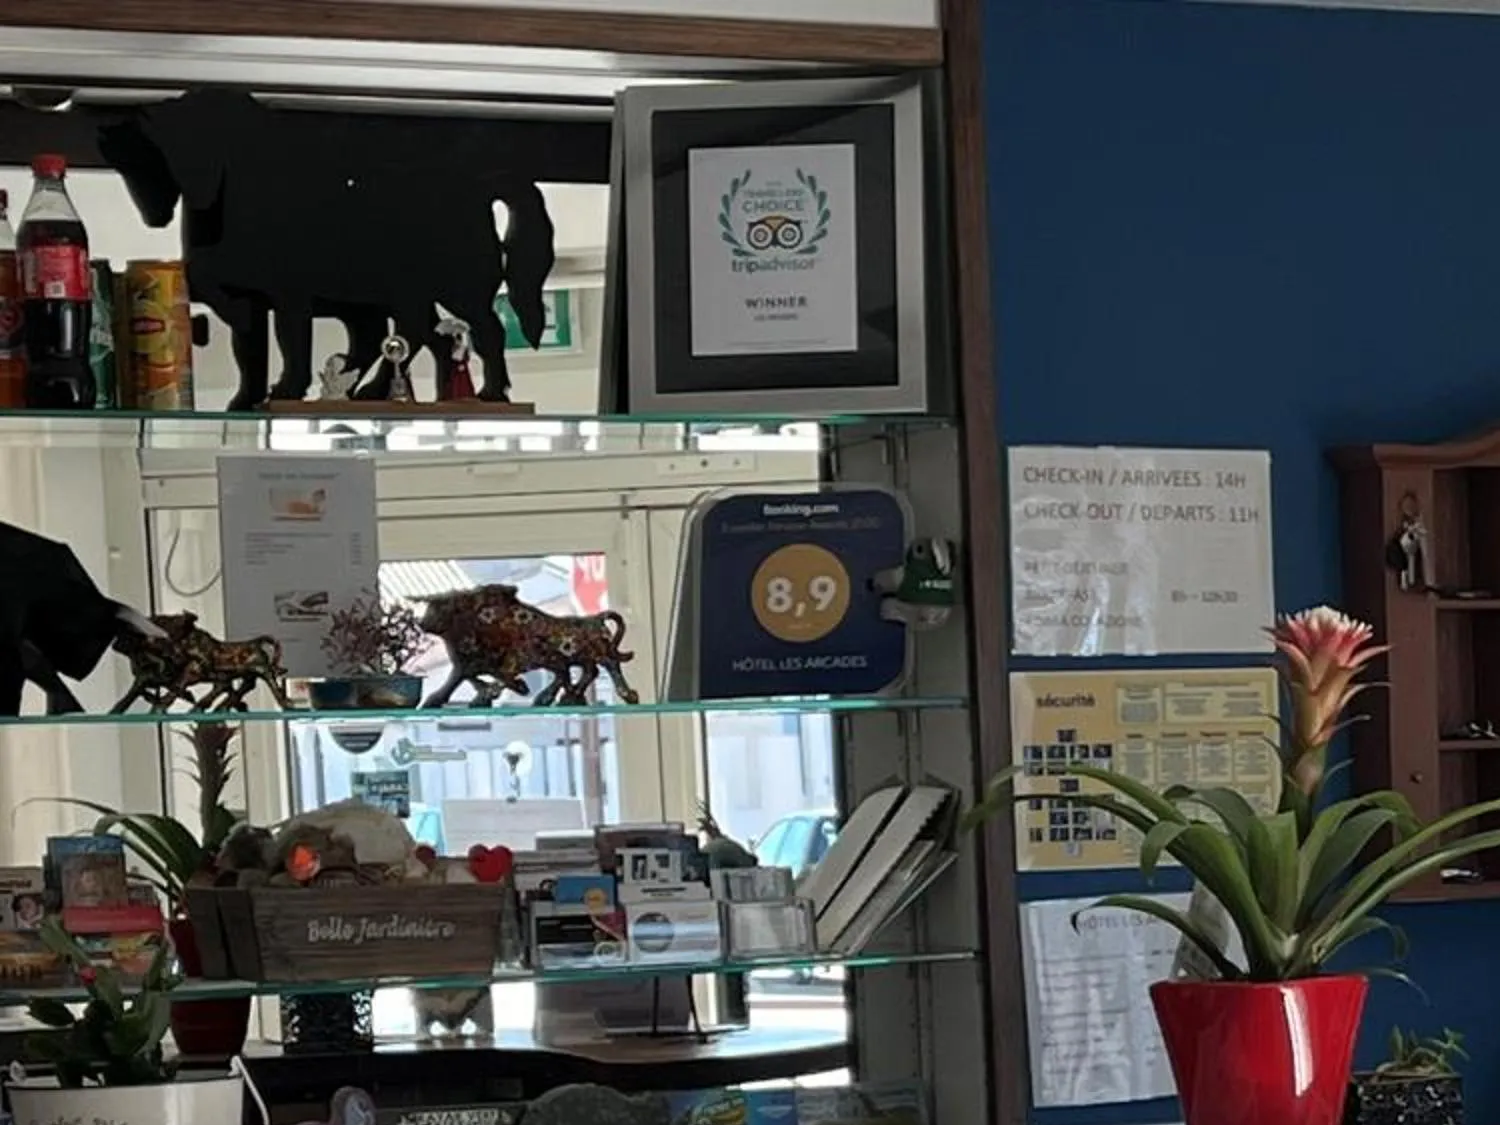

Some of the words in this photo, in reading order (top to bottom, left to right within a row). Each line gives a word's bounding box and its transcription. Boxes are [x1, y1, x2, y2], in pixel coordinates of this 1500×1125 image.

[742, 199, 805, 213] CHOICE
[745, 295, 808, 309] WINNER
[1022, 466, 1104, 486] CHECK-IN
[1120, 468, 1202, 488] ARRIVEES
[1214, 471, 1247, 490] 14H
[1023, 501, 1080, 520] CHECK
[1086, 503, 1124, 520] OUT
[1140, 504, 1216, 522] DEPARTS
[1228, 506, 1260, 523] 11H
[764, 575, 838, 618] 8,9
[731, 656, 776, 672] HÔTEL
[779, 656, 803, 671] LES
[804, 654, 868, 670] ARCADES
